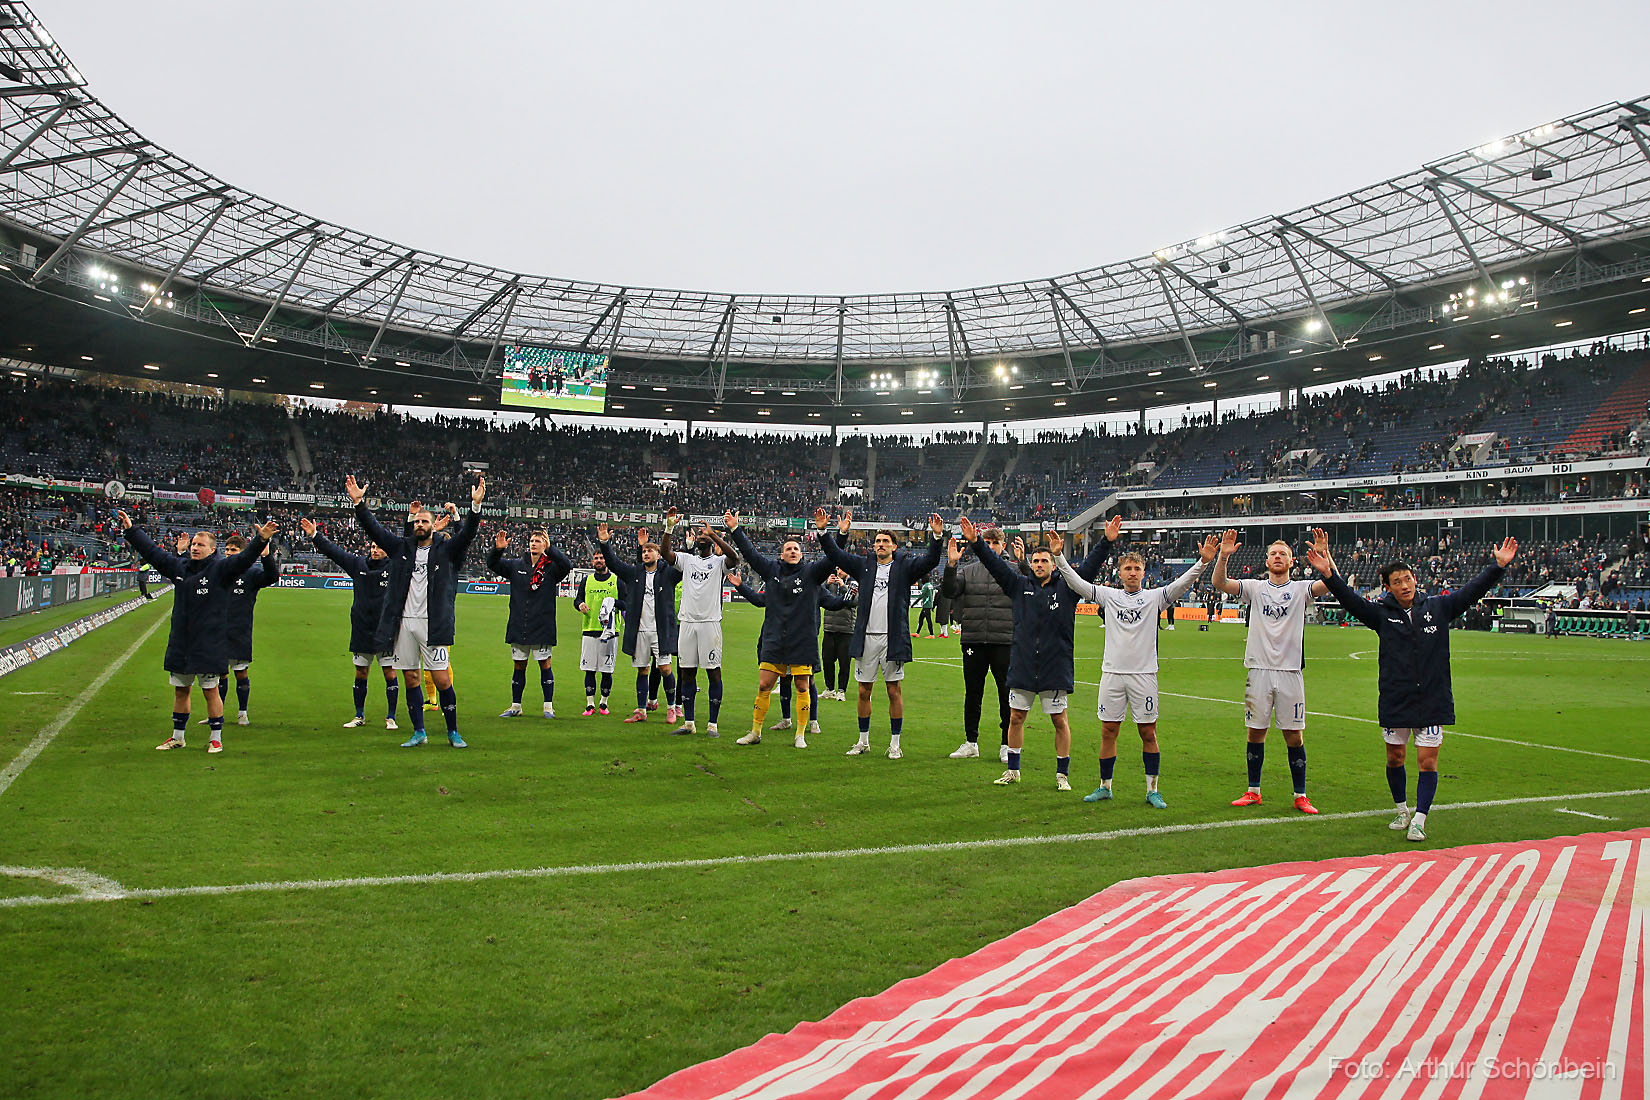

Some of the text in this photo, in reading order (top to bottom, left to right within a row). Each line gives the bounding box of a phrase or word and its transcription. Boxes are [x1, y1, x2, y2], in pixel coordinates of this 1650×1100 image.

[1466, 470, 1488, 478] KIND
[1552, 464, 1572, 474] HDI
[149, 573, 160, 582] eise
[278, 576, 305, 586] heise
[432, 648, 447, 661] 20
[709, 650, 715, 661] 6
[1145, 696, 1153, 711] 8
[1294, 703, 1304, 719] 17
